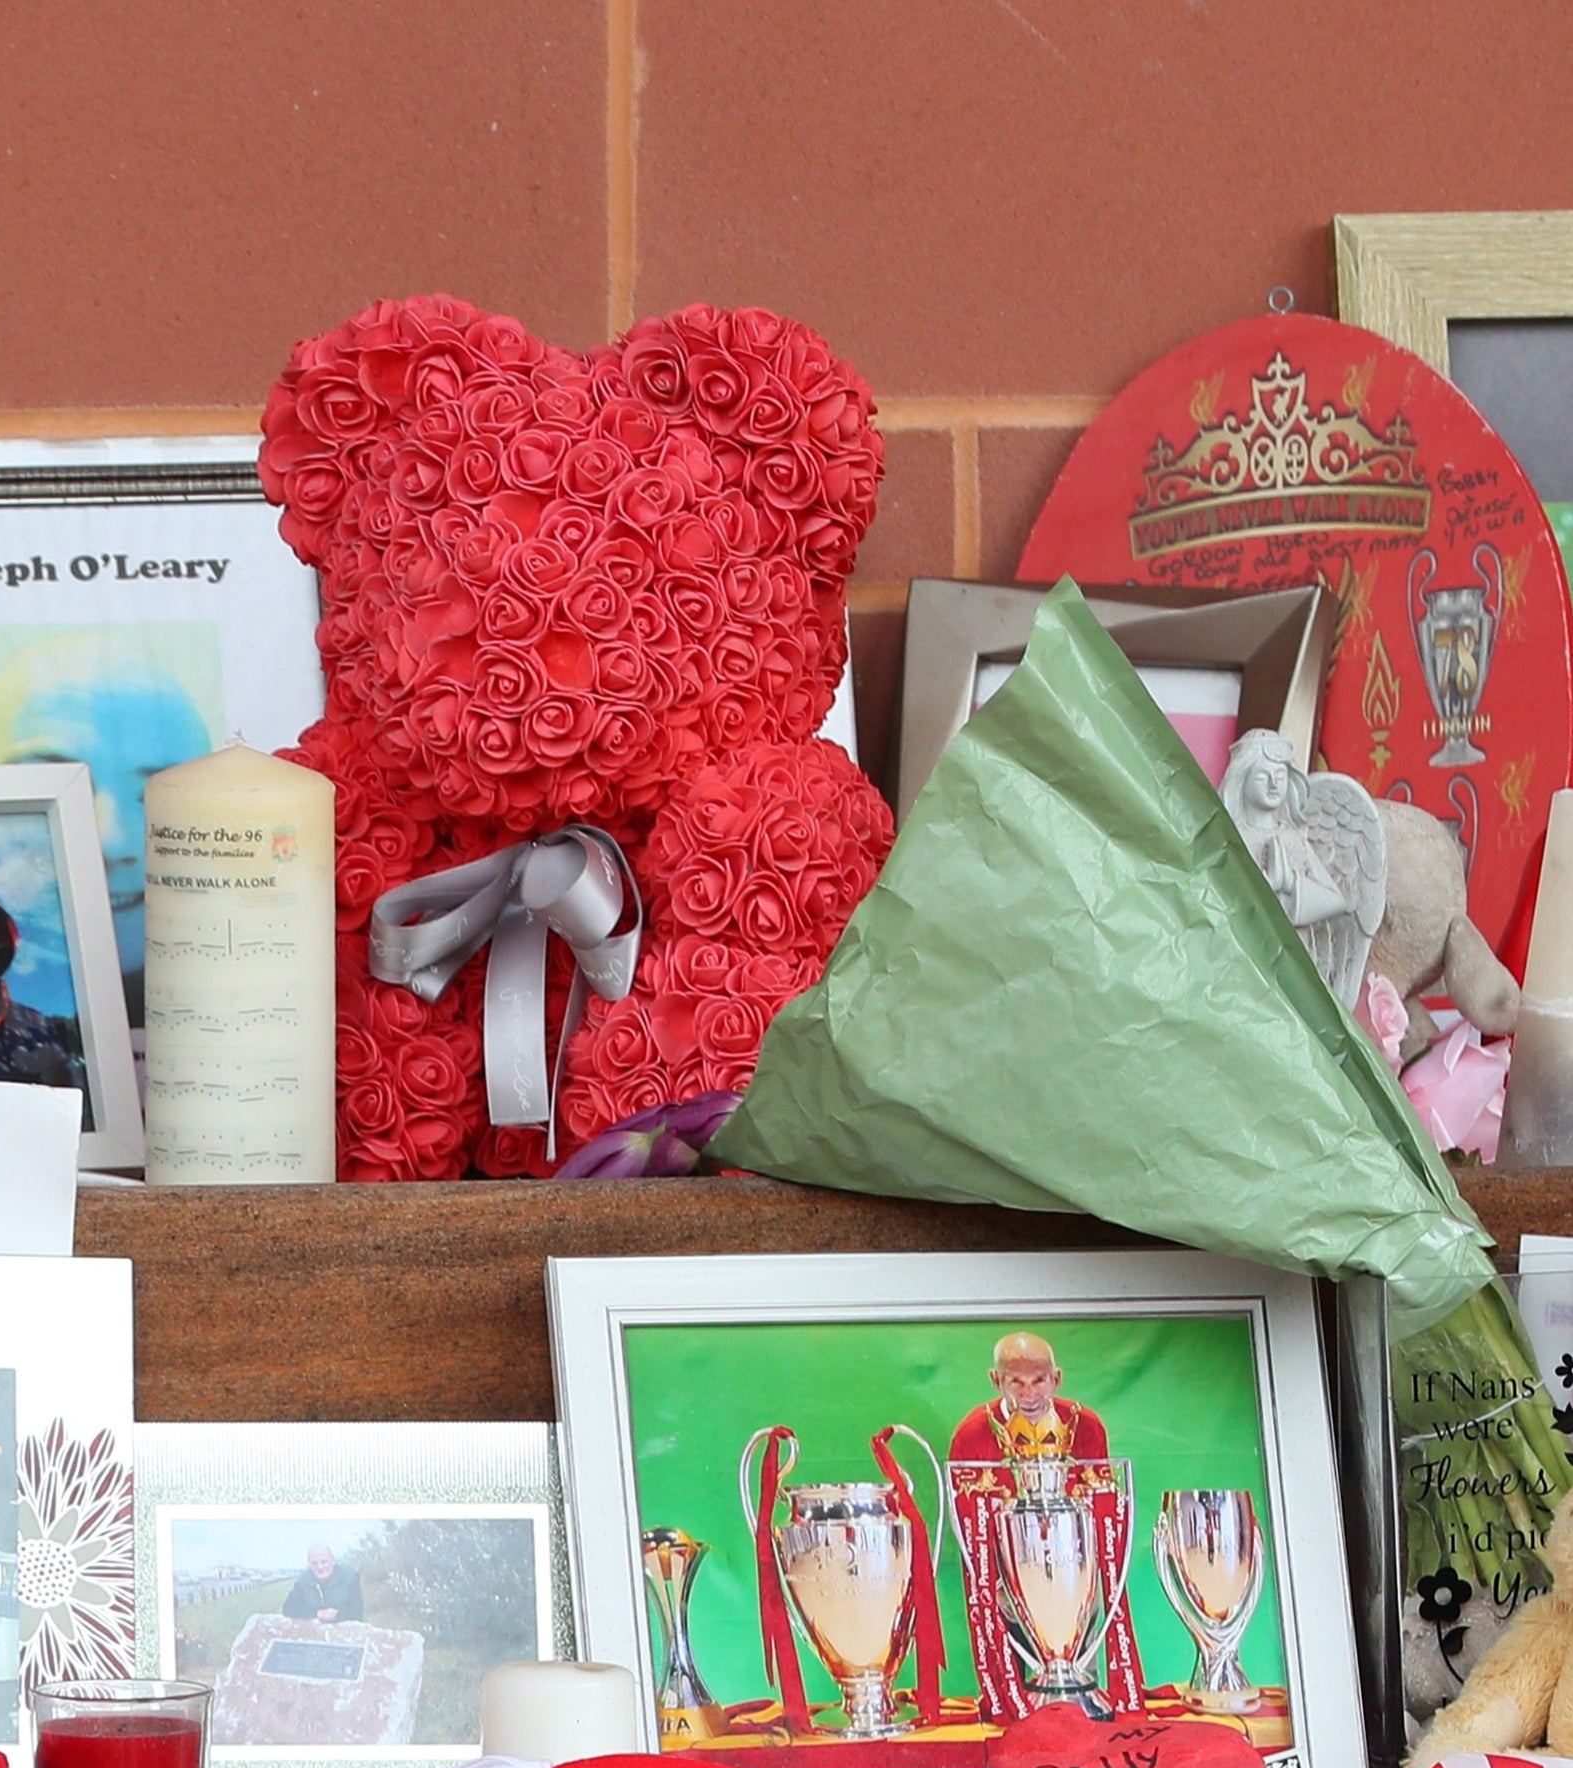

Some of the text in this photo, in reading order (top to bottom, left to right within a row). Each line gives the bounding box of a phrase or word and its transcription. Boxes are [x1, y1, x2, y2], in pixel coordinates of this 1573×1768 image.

[69, 553, 231, 586] O'Leary
[1434, 627, 1477, 698] 78
[187, 826, 209, 844] for
[214, 828, 241, 843] the
[244, 829, 263, 843] 96
[193, 847, 210, 858] the
[210, 848, 254, 860] families
[161, 876, 192, 888] NEVER
[196, 878, 231, 889] WALK
[235, 876, 277, 889] ALONE
[1410, 1371, 1537, 1402] If Nans
[1432, 1417, 1515, 1442] were
[1409, 1453, 1557, 1502] Flowers
[1448, 1521, 1494, 1555] i'd
